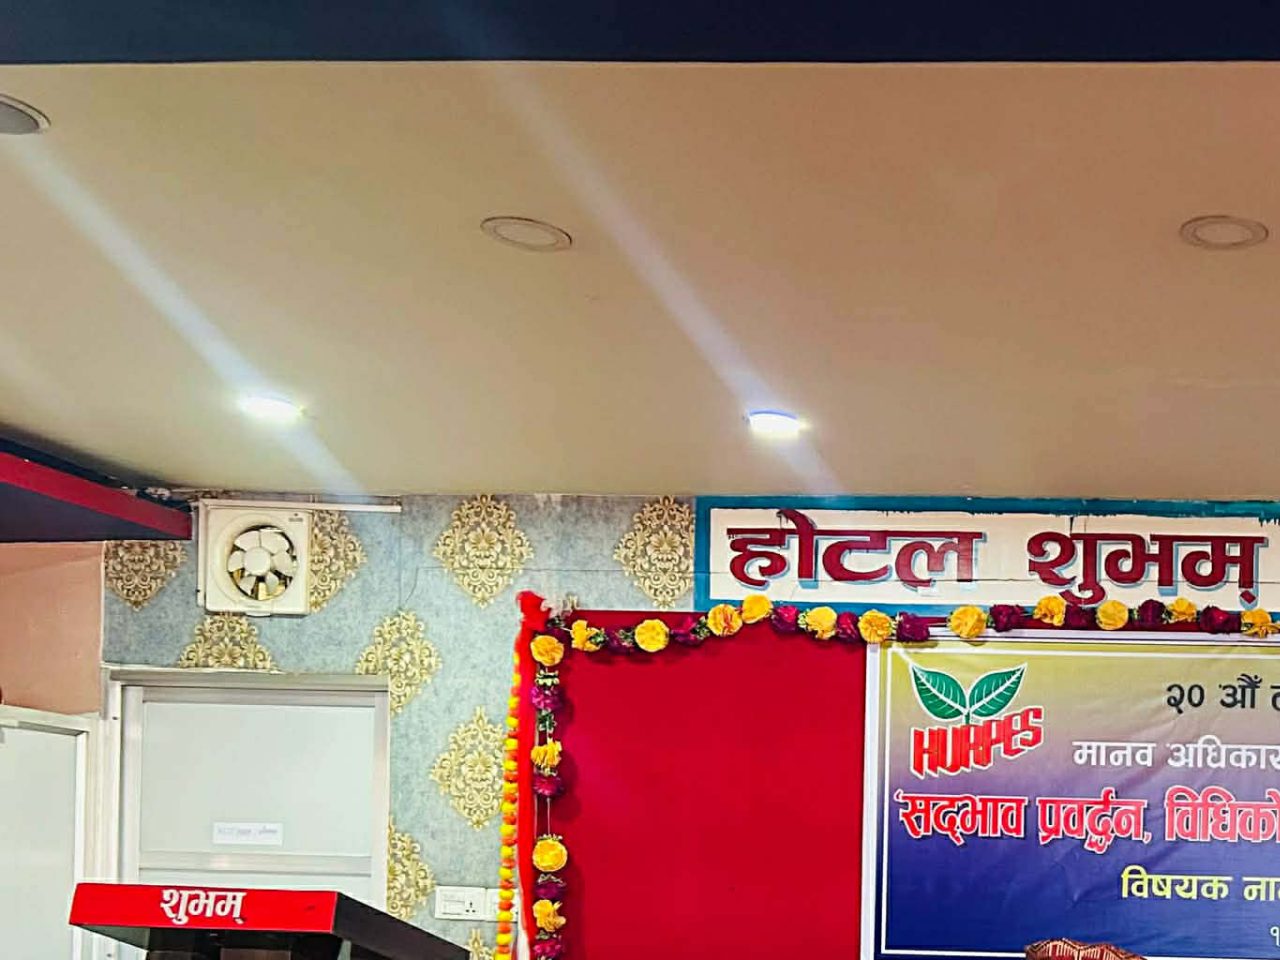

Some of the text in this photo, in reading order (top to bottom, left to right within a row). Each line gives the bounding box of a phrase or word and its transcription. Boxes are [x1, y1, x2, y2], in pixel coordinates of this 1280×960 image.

[727, 508, 987, 590] होटल
[1166, 683, 1205, 714] २०
[1072, 740, 1156, 768] मानव
[1120, 864, 1233, 900] विषयक
